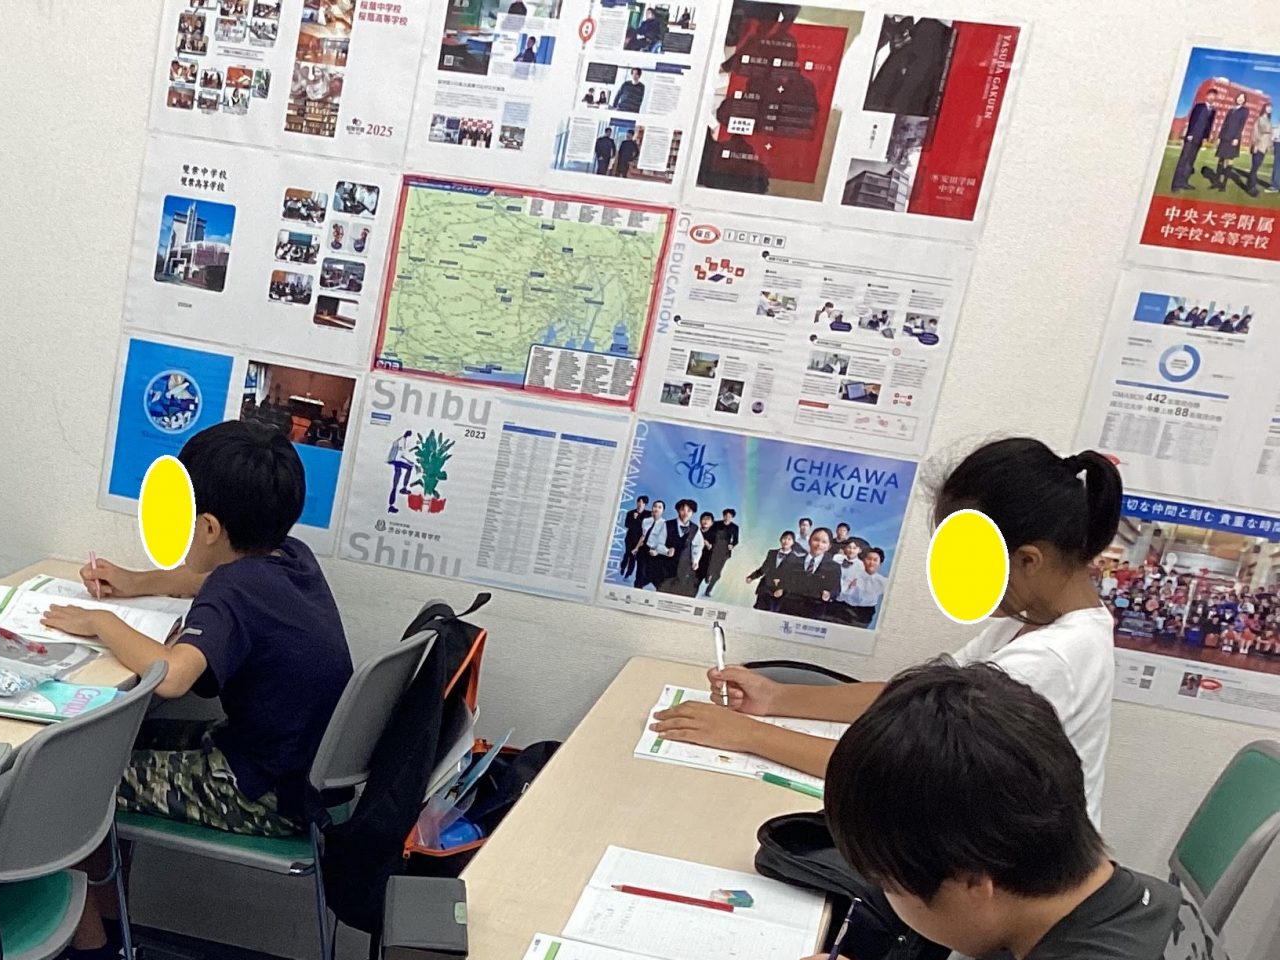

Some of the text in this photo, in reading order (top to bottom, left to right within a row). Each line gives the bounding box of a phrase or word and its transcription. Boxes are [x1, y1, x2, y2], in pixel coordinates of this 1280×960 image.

[984, 35, 1012, 119] YASUDA GAKUEN
[366, 123, 394, 137] 2025
[1165, 206, 1275, 234] 中央大学附属
[1160, 224, 1270, 249] 中学校・高等学校
[656, 242, 686, 335] EDUCATION
[371, 380, 492, 425] Shibu
[1145, 392, 1167, 404] 442
[1174, 407, 1189, 417] 88
[464, 429, 486, 440] 2023
[786, 456, 899, 489] ICHIKAWA
[791, 476, 888, 505] GAKUEN
